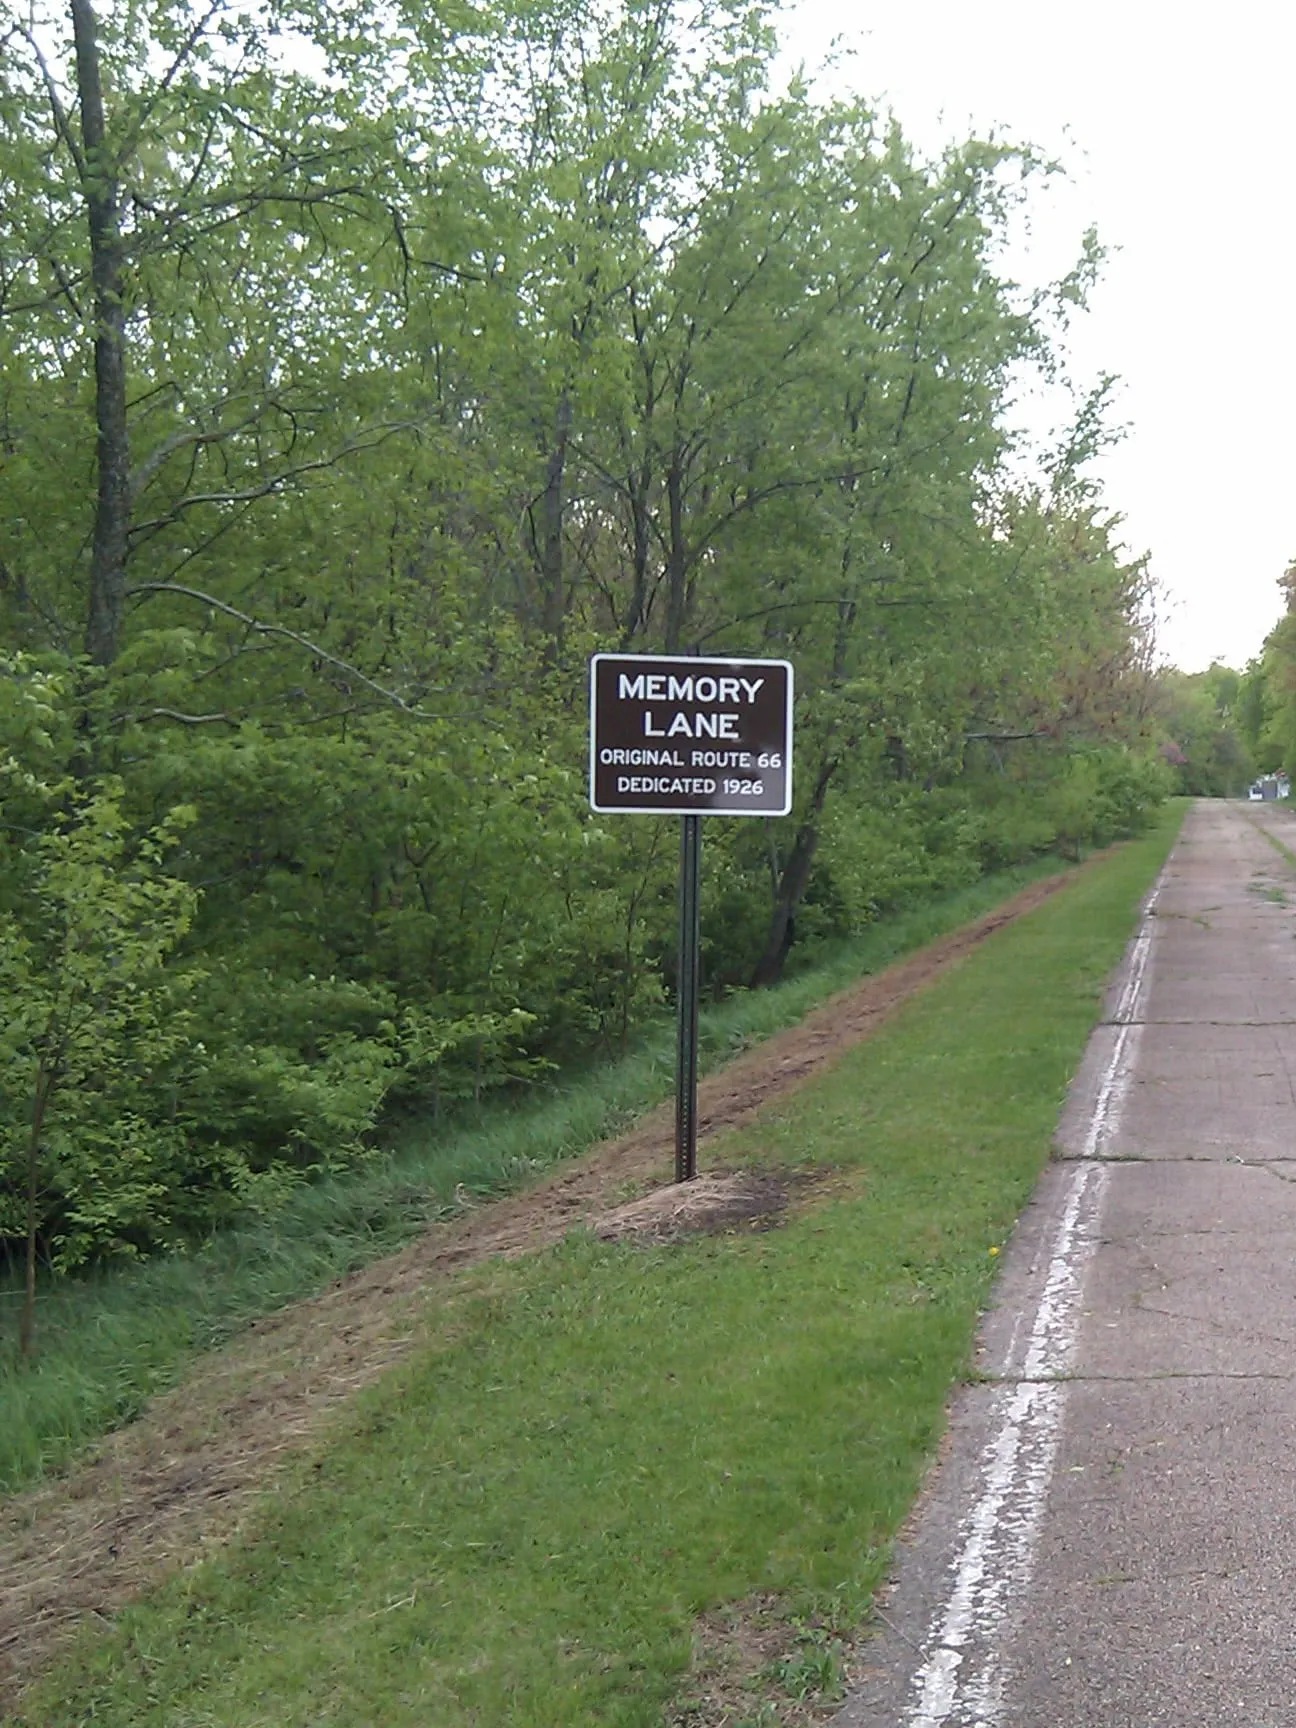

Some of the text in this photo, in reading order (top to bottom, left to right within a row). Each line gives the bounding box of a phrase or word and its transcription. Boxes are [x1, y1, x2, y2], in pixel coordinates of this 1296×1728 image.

[619, 674, 764, 703] MEMORY
[644, 710, 740, 739] LANE
[600, 748, 782, 769] ORIGINAL ROUTE 66
[617, 776, 764, 795] DEDICATED 1926
